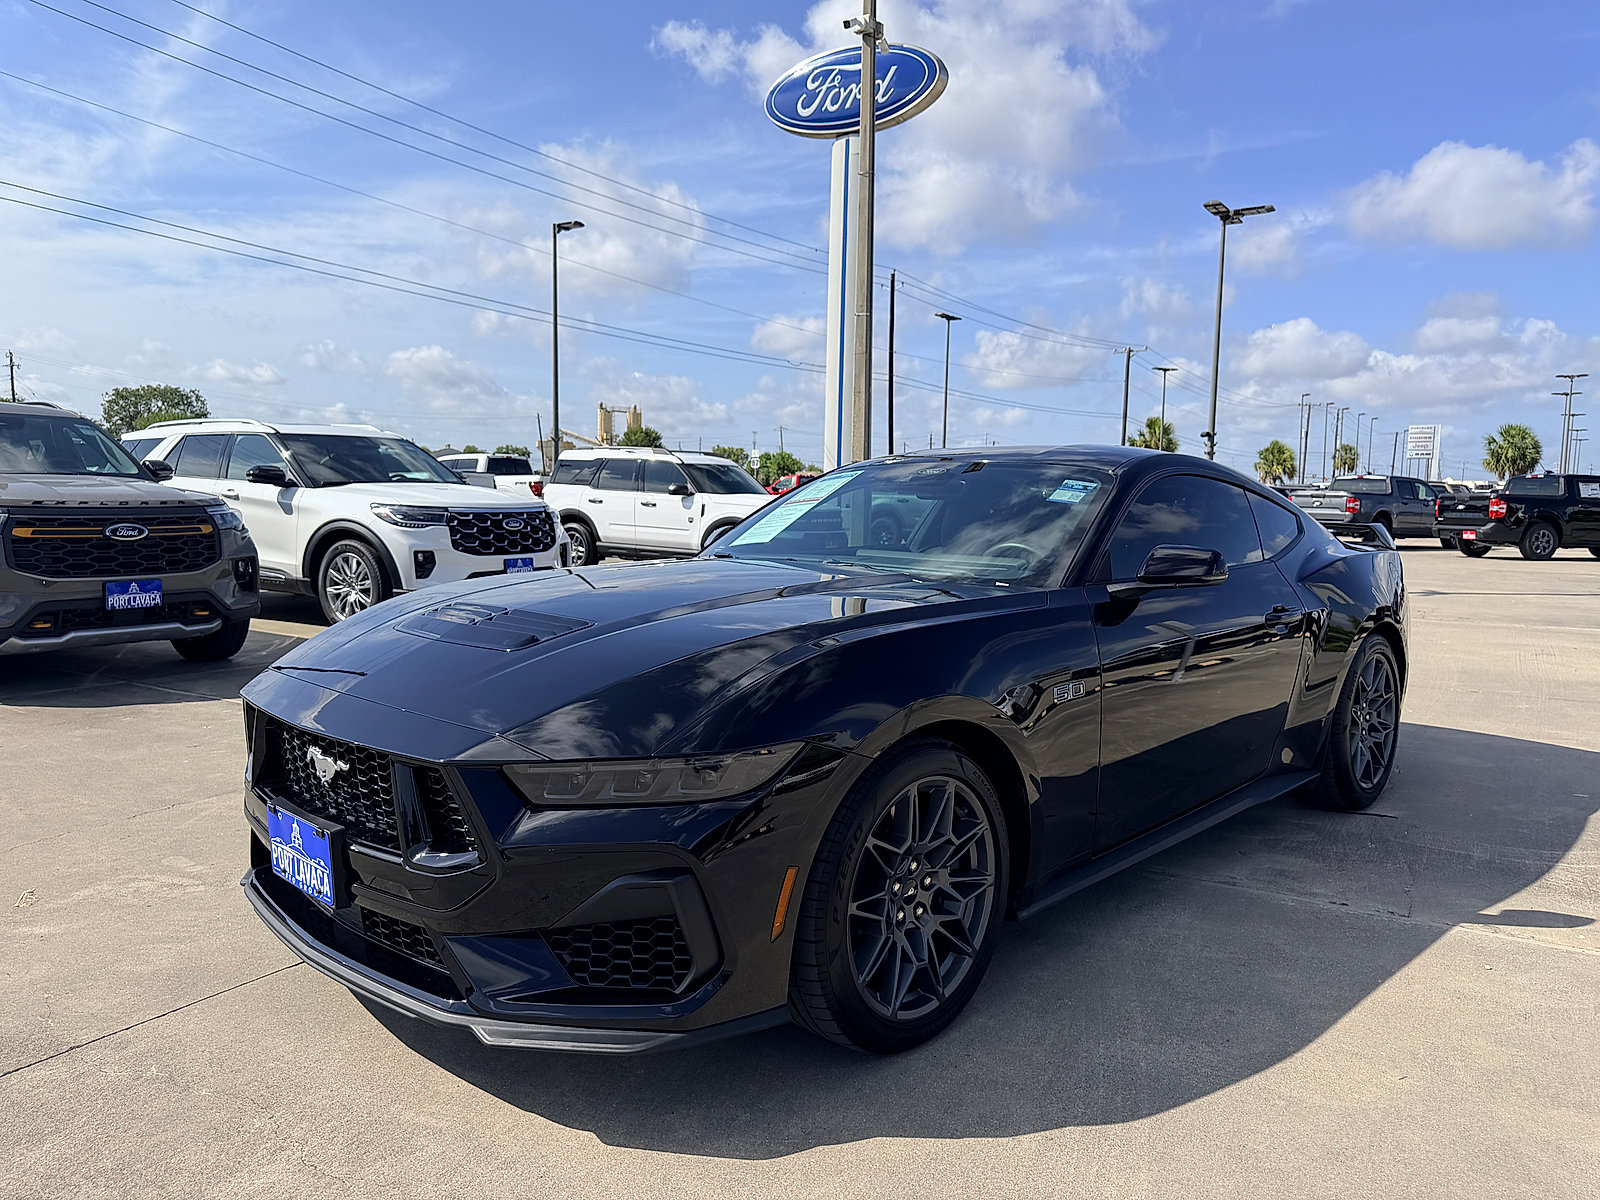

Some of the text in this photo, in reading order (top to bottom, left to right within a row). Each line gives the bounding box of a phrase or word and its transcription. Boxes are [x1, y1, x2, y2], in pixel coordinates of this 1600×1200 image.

[797, 63, 897, 117] Ford
[116, 526, 139, 537] Ford
[108, 594, 161, 608] PORT LAVACA
[271, 842, 331, 897] PORT LAVACA
